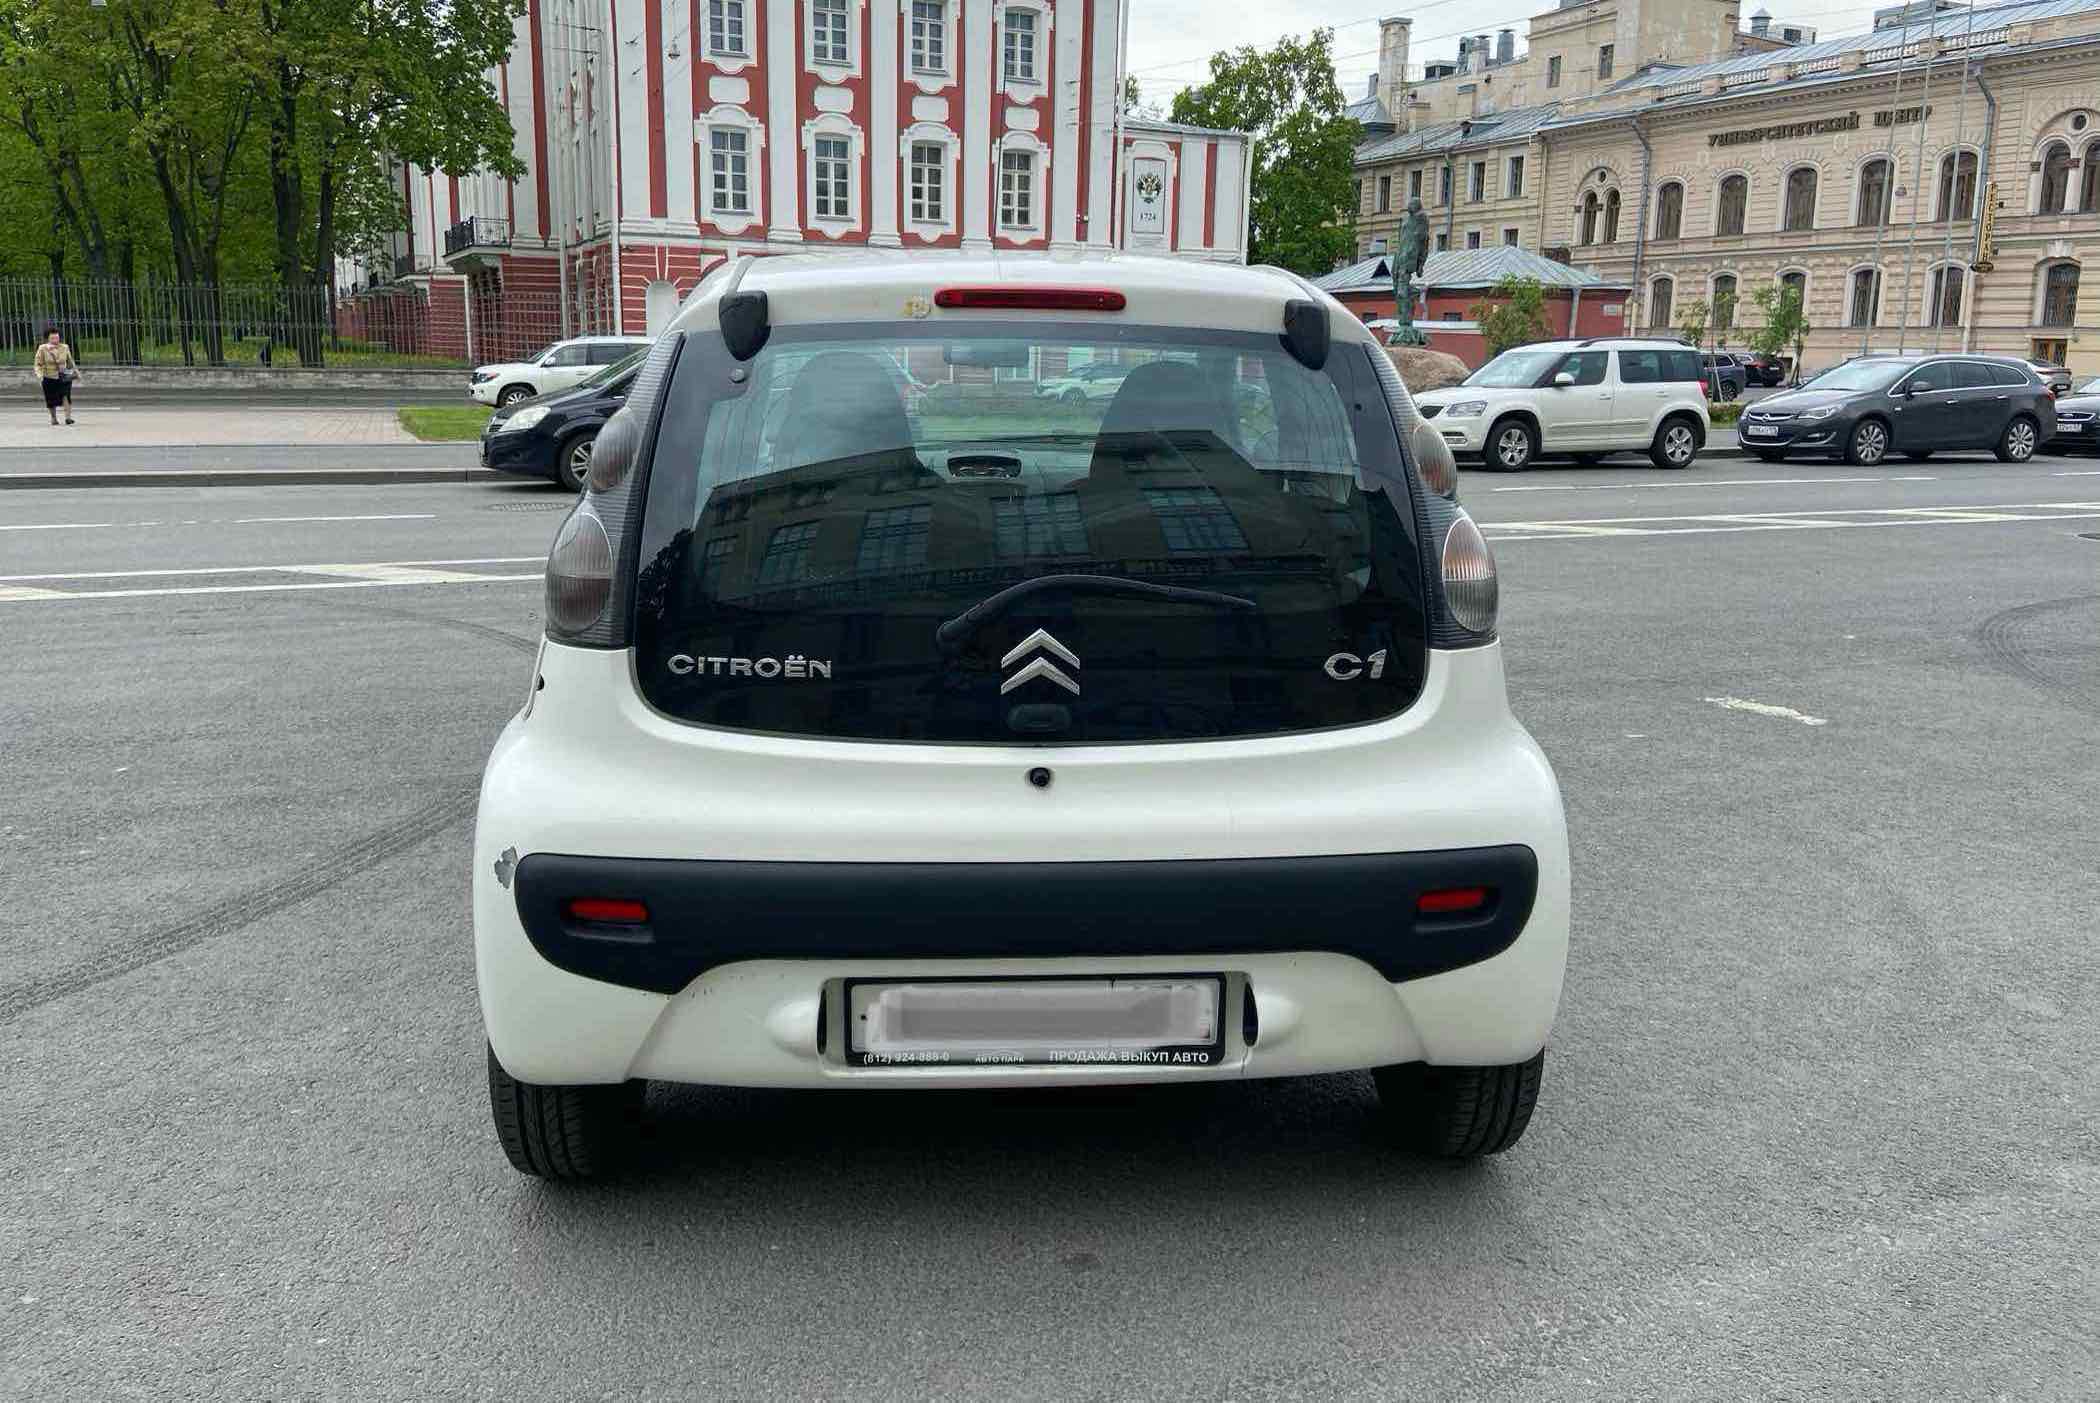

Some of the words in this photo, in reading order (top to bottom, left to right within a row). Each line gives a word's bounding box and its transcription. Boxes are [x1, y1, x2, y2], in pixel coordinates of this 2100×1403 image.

[1139, 212, 1156, 221] 1724
[667, 654, 832, 678] CITROËN
[1324, 649, 1387, 680] C1
[863, 1053, 892, 1064] (812)
[1050, 1050, 1117, 1063] ПРОДАЖА
[1121, 1051, 1169, 1063] ВЫКУП
[1172, 1052, 1209, 1064] АВТО
